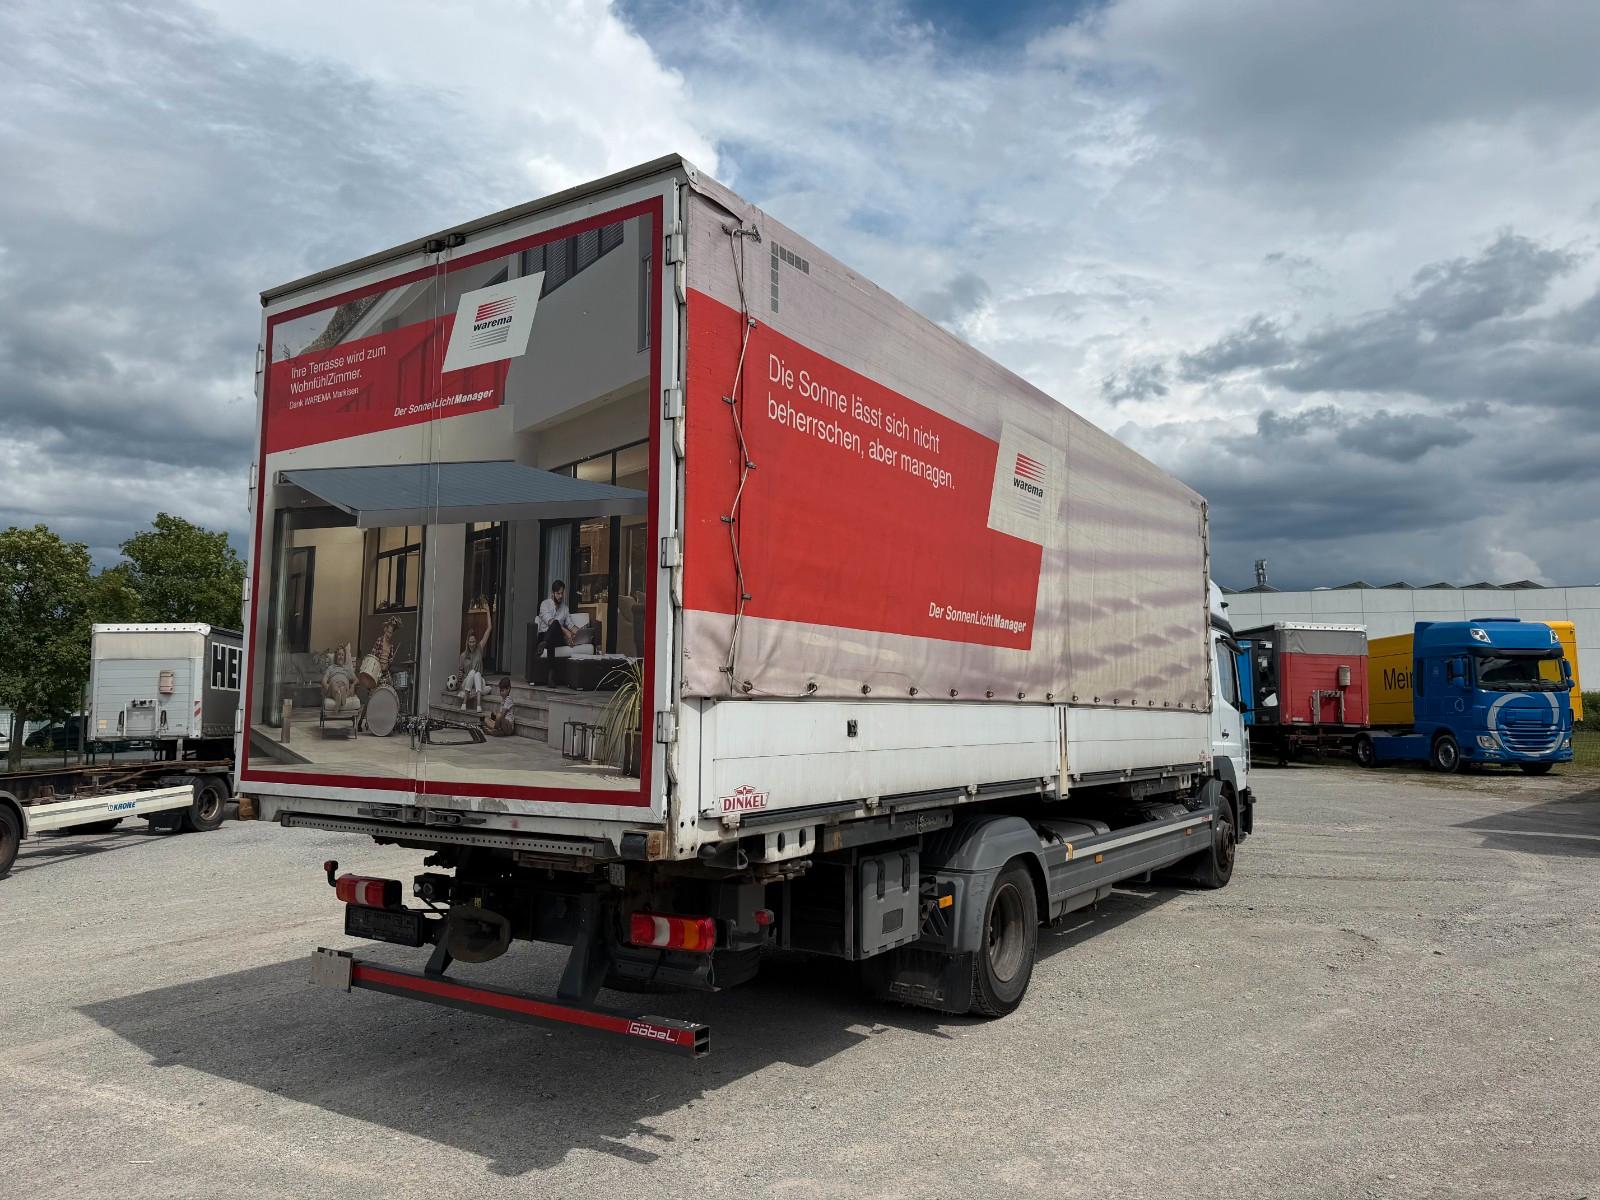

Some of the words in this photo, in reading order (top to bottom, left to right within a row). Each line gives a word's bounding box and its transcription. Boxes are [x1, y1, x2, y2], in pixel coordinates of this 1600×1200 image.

[473, 315, 512, 332] warema
[291, 367, 306, 379] Ihre
[309, 356, 344, 374] Terrasse
[346, 349, 364, 364] wird
[367, 345, 386, 359] zum
[290, 368, 362, 395] WohnfühlZimmer.
[304, 394, 331, 406] WAREMA
[394, 407, 407, 416] Der
[769, 353, 794, 390] Die
[799, 370, 847, 413] Sonne
[851, 394, 882, 429] lässt
[885, 413, 910, 440] sich
[913, 425, 940, 454] nicht
[768, 392, 864, 459] beherrschen,
[868, 438, 897, 467] aber
[901, 453, 955, 490] managen.
[1013, 477, 1044, 498] warema
[929, 602, 944, 619] Der
[945, 605, 1027, 634] SonnenLichtManager
[211, 641, 243, 691] HE
[113, 801, 136, 811] KRONE
[723, 794, 766, 811] DINKEL
